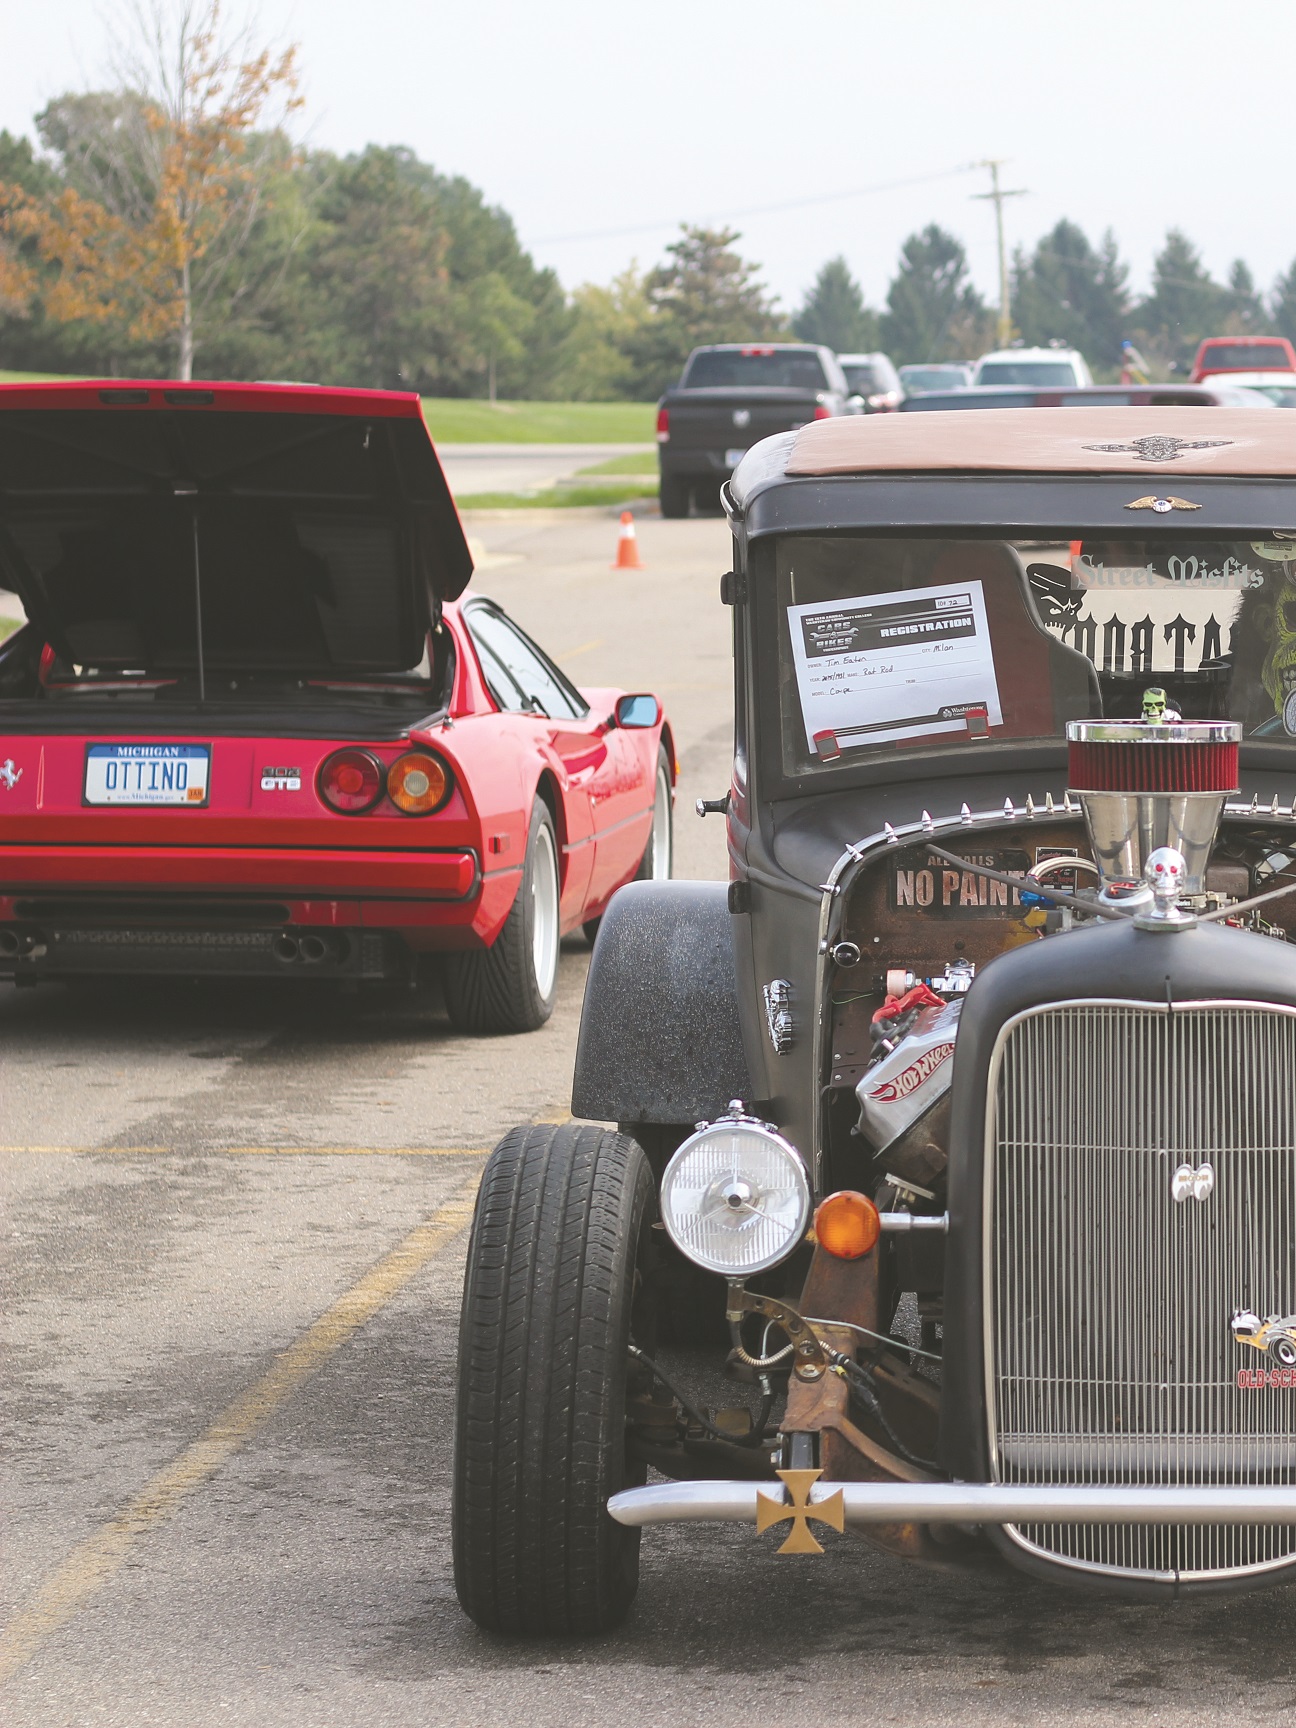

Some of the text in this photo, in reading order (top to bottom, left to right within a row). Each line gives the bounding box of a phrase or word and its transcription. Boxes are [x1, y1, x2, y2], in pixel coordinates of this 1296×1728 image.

[1075, 554, 1157, 588] Street
[1163, 555, 1265, 589] Misfits
[817, 621, 851, 632] CARS
[880, 617, 972, 638] REGISTRATION
[816, 637, 853, 649] BIKES
[825, 658, 840, 667] Tim
[932, 643, 954, 653] Milan
[117, 746, 179, 757] MICHIGAN
[896, 870, 934, 906] NO
[942, 870, 1026, 906] PAINT
